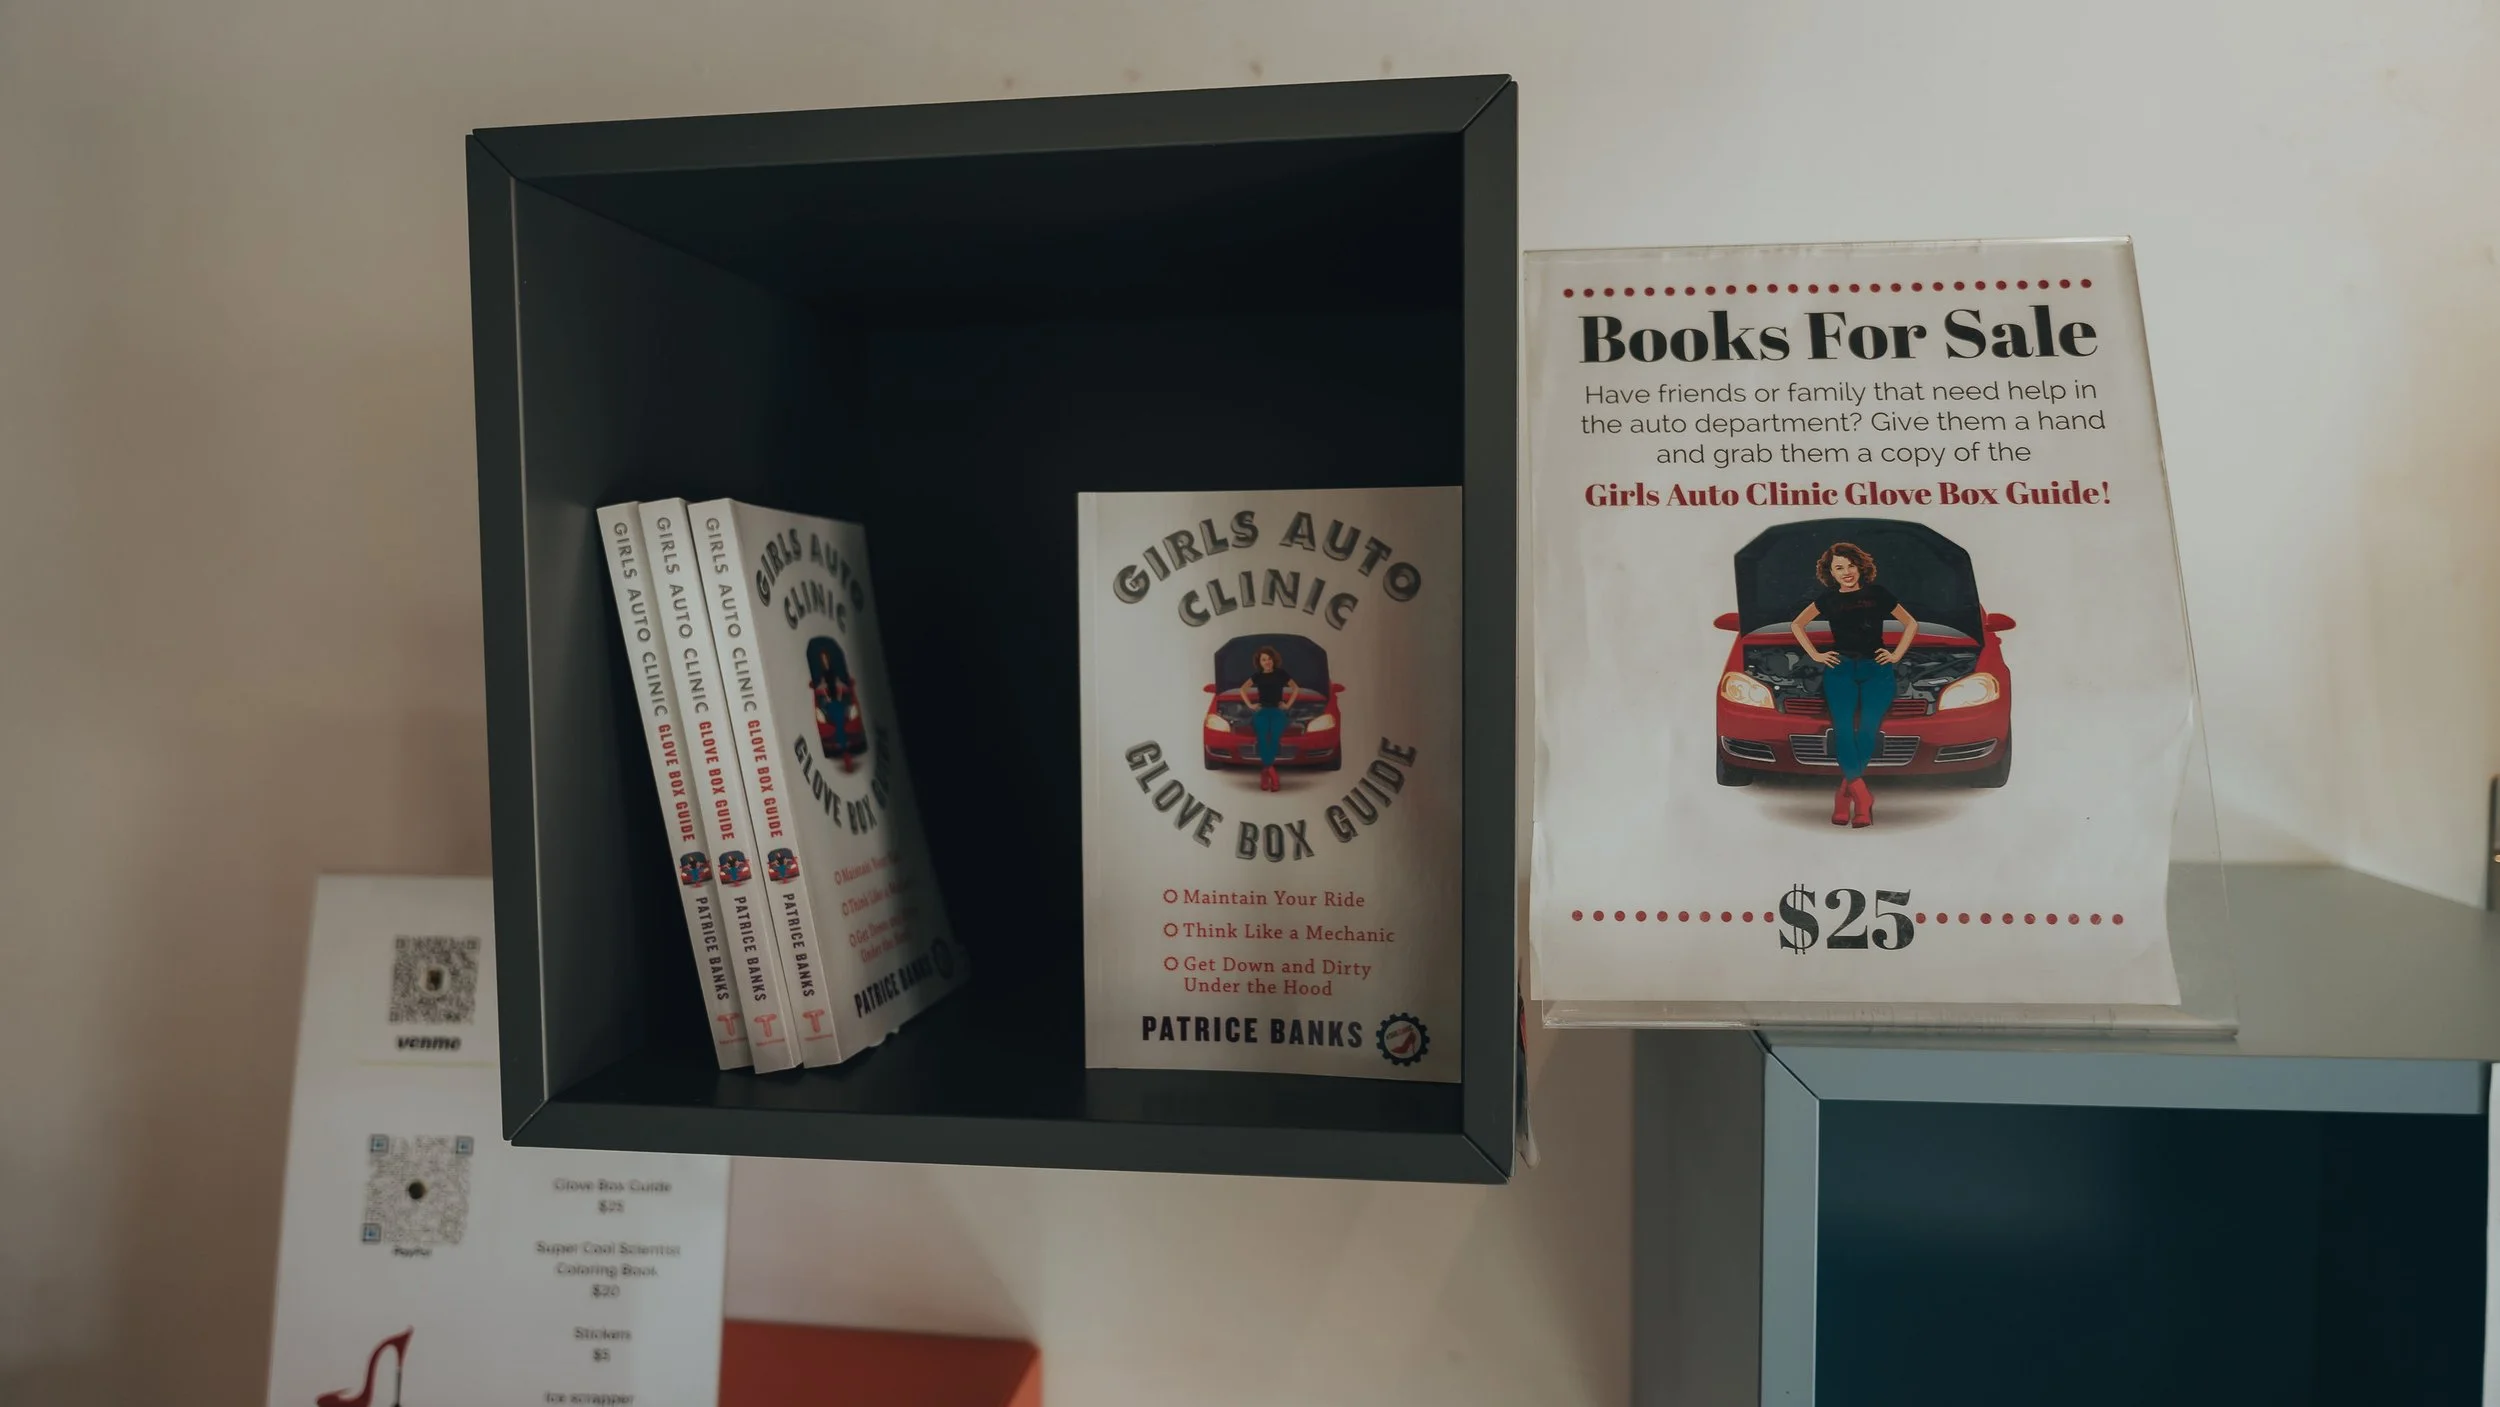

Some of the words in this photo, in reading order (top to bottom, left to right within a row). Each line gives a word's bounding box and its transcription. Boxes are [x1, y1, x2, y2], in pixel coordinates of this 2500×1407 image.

[1578, 310, 1791, 363] Books
[1805, 311, 1927, 360] For
[1944, 305, 2098, 360] Sale
[1585, 385, 1650, 405] Have
[1658, 382, 1746, 404] friends
[1755, 387, 1780, 403] or
[1788, 381, 1866, 406] family
[1874, 380, 1924, 402] that
[1932, 380, 2001, 401] need
[2008, 380, 2066, 406] help
[2075, 380, 2097, 399] in
[1581, 414, 1621, 434] the
[1631, 417, 1686, 434] auto
[1696, 413, 1862, 438] department?
[1872, 412, 1929, 432] Give
[1937, 412, 2006, 431] them
[2015, 416, 2029, 430] a
[2038, 411, 2104, 430] hand
[1657, 445, 1704, 464] and
[1714, 444, 1772, 468] grab
[1781, 444, 1849, 463] them
[1858, 448, 1872, 462] a
[1882, 446, 1946, 467] copy
[1954, 442, 1981, 462] of
[1985, 442, 2031, 462] the
[1585, 483, 1660, 507] Girls
[1667, 483, 1738, 507] Auto
[1746, 482, 1838, 506] Clinic
[1845, 482, 1931, 506] Glove
[1940, 482, 1999, 505] Box
[2006, 482, 2111, 505] Guide!
[614, 522, 637, 579] GIRLS
[656, 517, 680, 574] GIRLS
[705, 517, 728, 574] GIRLS
[756, 528, 802, 607] GIRLS
[810, 532, 864, 612] AUTO
[1112, 510, 1259, 604] GIRLS
[1279, 511, 1422, 603] AUTO
[627, 588, 651, 642] AUTO
[669, 584, 693, 639] AUTO
[718, 584, 741, 638] AUTO
[784, 579, 846, 633] CLINIC
[1177, 568, 1359, 631] CLINIC
[642, 652, 668, 717] CLINIC
[683, 648, 709, 714] CLINIC
[732, 647, 757, 712] CLINIC
[658, 724, 679, 766] GLOVE
[699, 721, 719, 764] GLOVE
[747, 720, 767, 762] GLOVE
[669, 771, 685, 797] BOX
[709, 768, 725, 795] BOX
[757, 766, 773, 793] BOX
[795, 734, 842, 828] GLOVE
[847, 795, 878, 835] BOX
[1124, 740, 1223, 847] GLOVE
[1235, 819, 1315, 862] BOX
[1324, 736, 1418, 843] GUIDE
[676, 801, 695, 841] GUIDE
[715, 799, 734, 840] GUIDE
[764, 797, 783, 838] GUIDE
[1183, 890, 1267, 905] Maintain
[1274, 890, 1318, 906] Your
[1324, 891, 1365, 908] Ride
[1778, 883, 1914, 955] $25
[696, 897, 719, 952] PATRICE
[709, 957, 729, 1000] BANKS
[734, 896, 757, 952] PATRICE
[747, 957, 766, 1001] BANKS
[783, 893, 805, 948] PATRICE
[796, 953, 814, 997] BANKS
[1183, 922, 1237, 938] Think
[1245, 924, 1283, 939] Like
[1290, 929, 1298, 939] a
[1306, 925, 1395, 942] Mechanic
[1184, 957, 1215, 972] Get
[1223, 957, 1274, 973] Down
[1282, 959, 1314, 974] and
[1322, 960, 1371, 980] Dirty
[1184, 978, 1240, 993] Under
[1248, 979, 1276, 994] the
[1284, 980, 1332, 996] Hood
[854, 972, 900, 1018] PATRICE
[396, 1036, 461, 1050] venmo
[1142, 1016, 1258, 1043] PATRICE
[1270, 1018, 1363, 1048] BANKS
